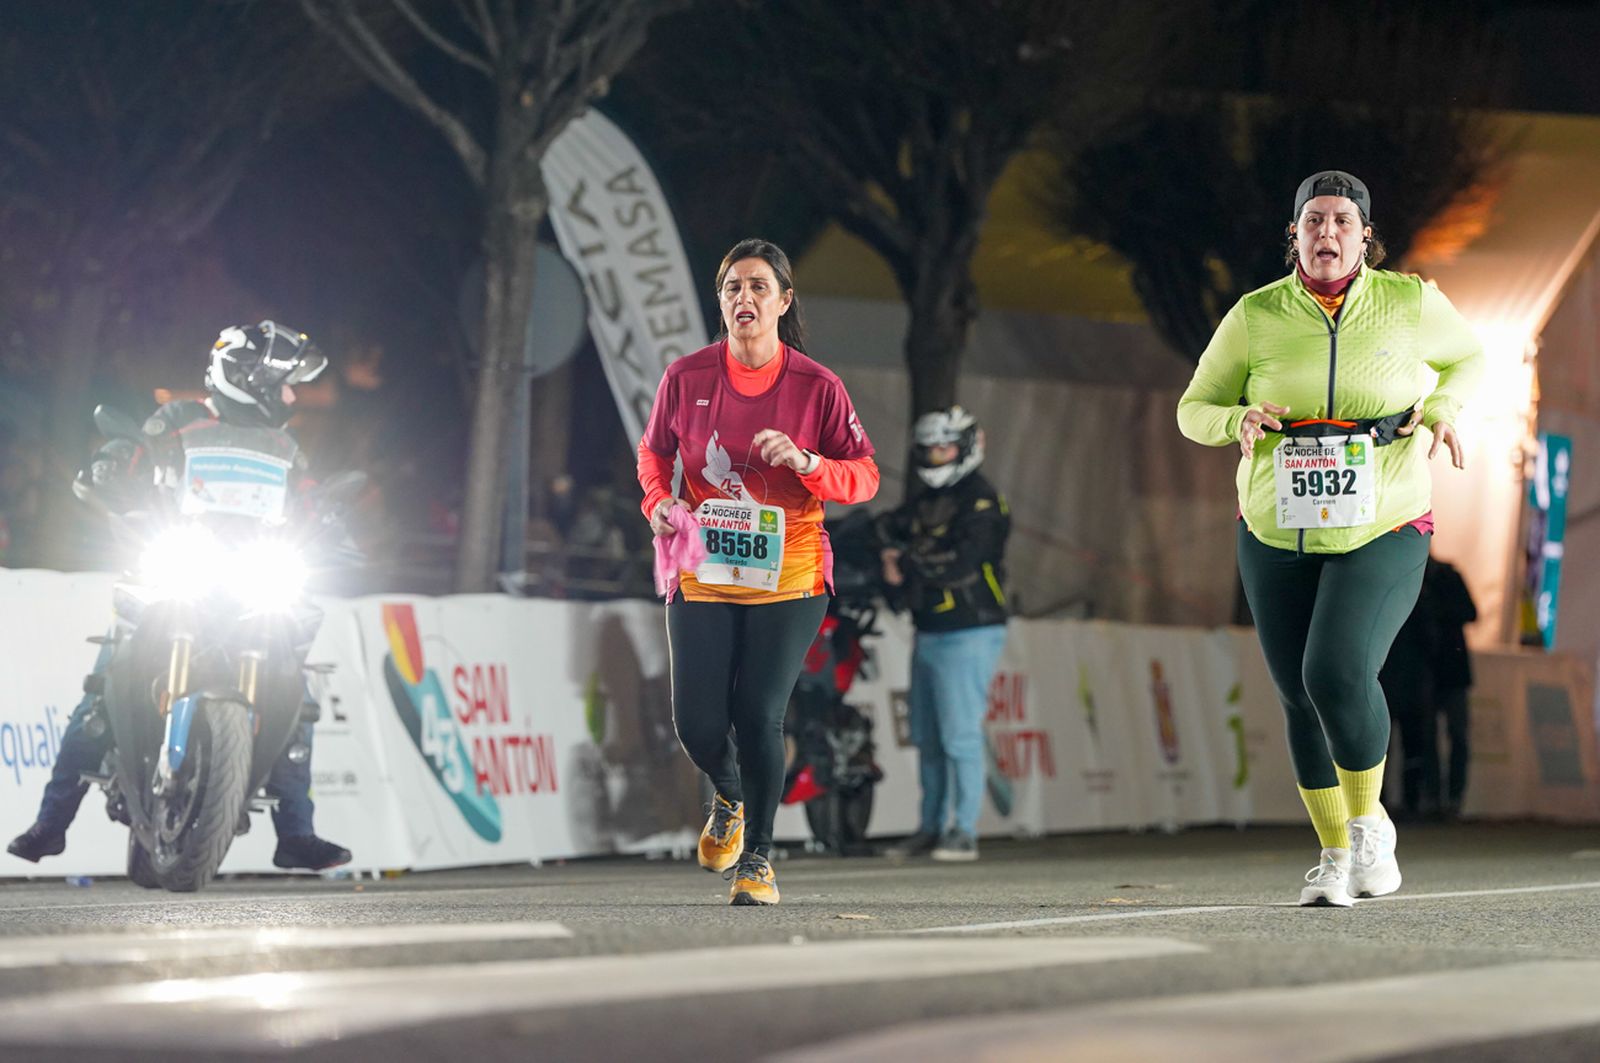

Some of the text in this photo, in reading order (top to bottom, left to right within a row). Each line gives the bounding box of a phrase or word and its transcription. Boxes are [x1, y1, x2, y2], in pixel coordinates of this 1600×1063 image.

[1294, 446, 1322, 457] NOCHE
[1324, 447, 1336, 456] DE
[1285, 459, 1303, 469] SAN
[1291, 468, 1357, 497] 5932
[1312, 498, 1336, 506] Carmen
[699, 517, 719, 528] SAN
[711, 507, 739, 519] NOCHE
[740, 509, 752, 520] DE
[705, 529, 768, 560] 8558
[452, 664, 511, 727] SAN
[421, 693, 464, 794] 43
[473, 716, 557, 797] ANTÓN
